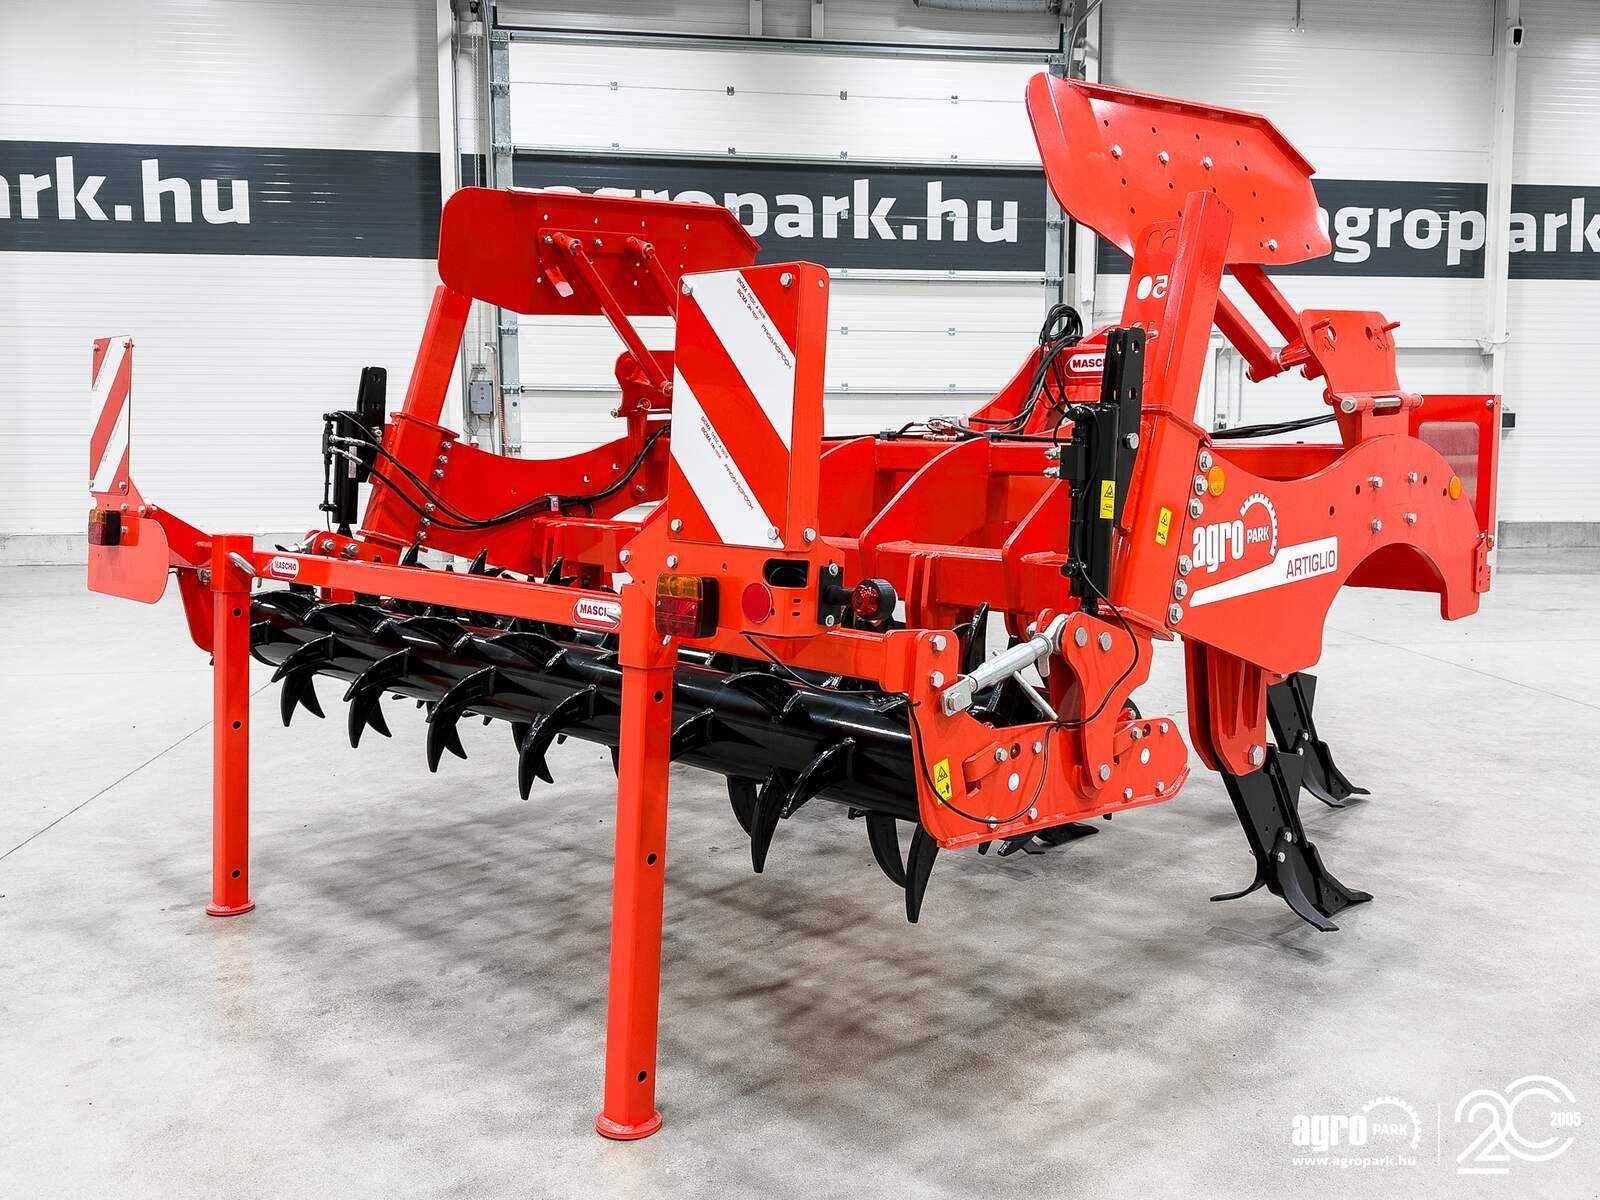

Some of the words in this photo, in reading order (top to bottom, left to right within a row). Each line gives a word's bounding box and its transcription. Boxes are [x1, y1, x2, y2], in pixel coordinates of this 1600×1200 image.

[1073, 358, 1105, 369] MASC
[1192, 519, 1244, 574] agro
[1247, 525, 1270, 544] PARK
[1286, 550, 1336, 579] ARTIGLIO
